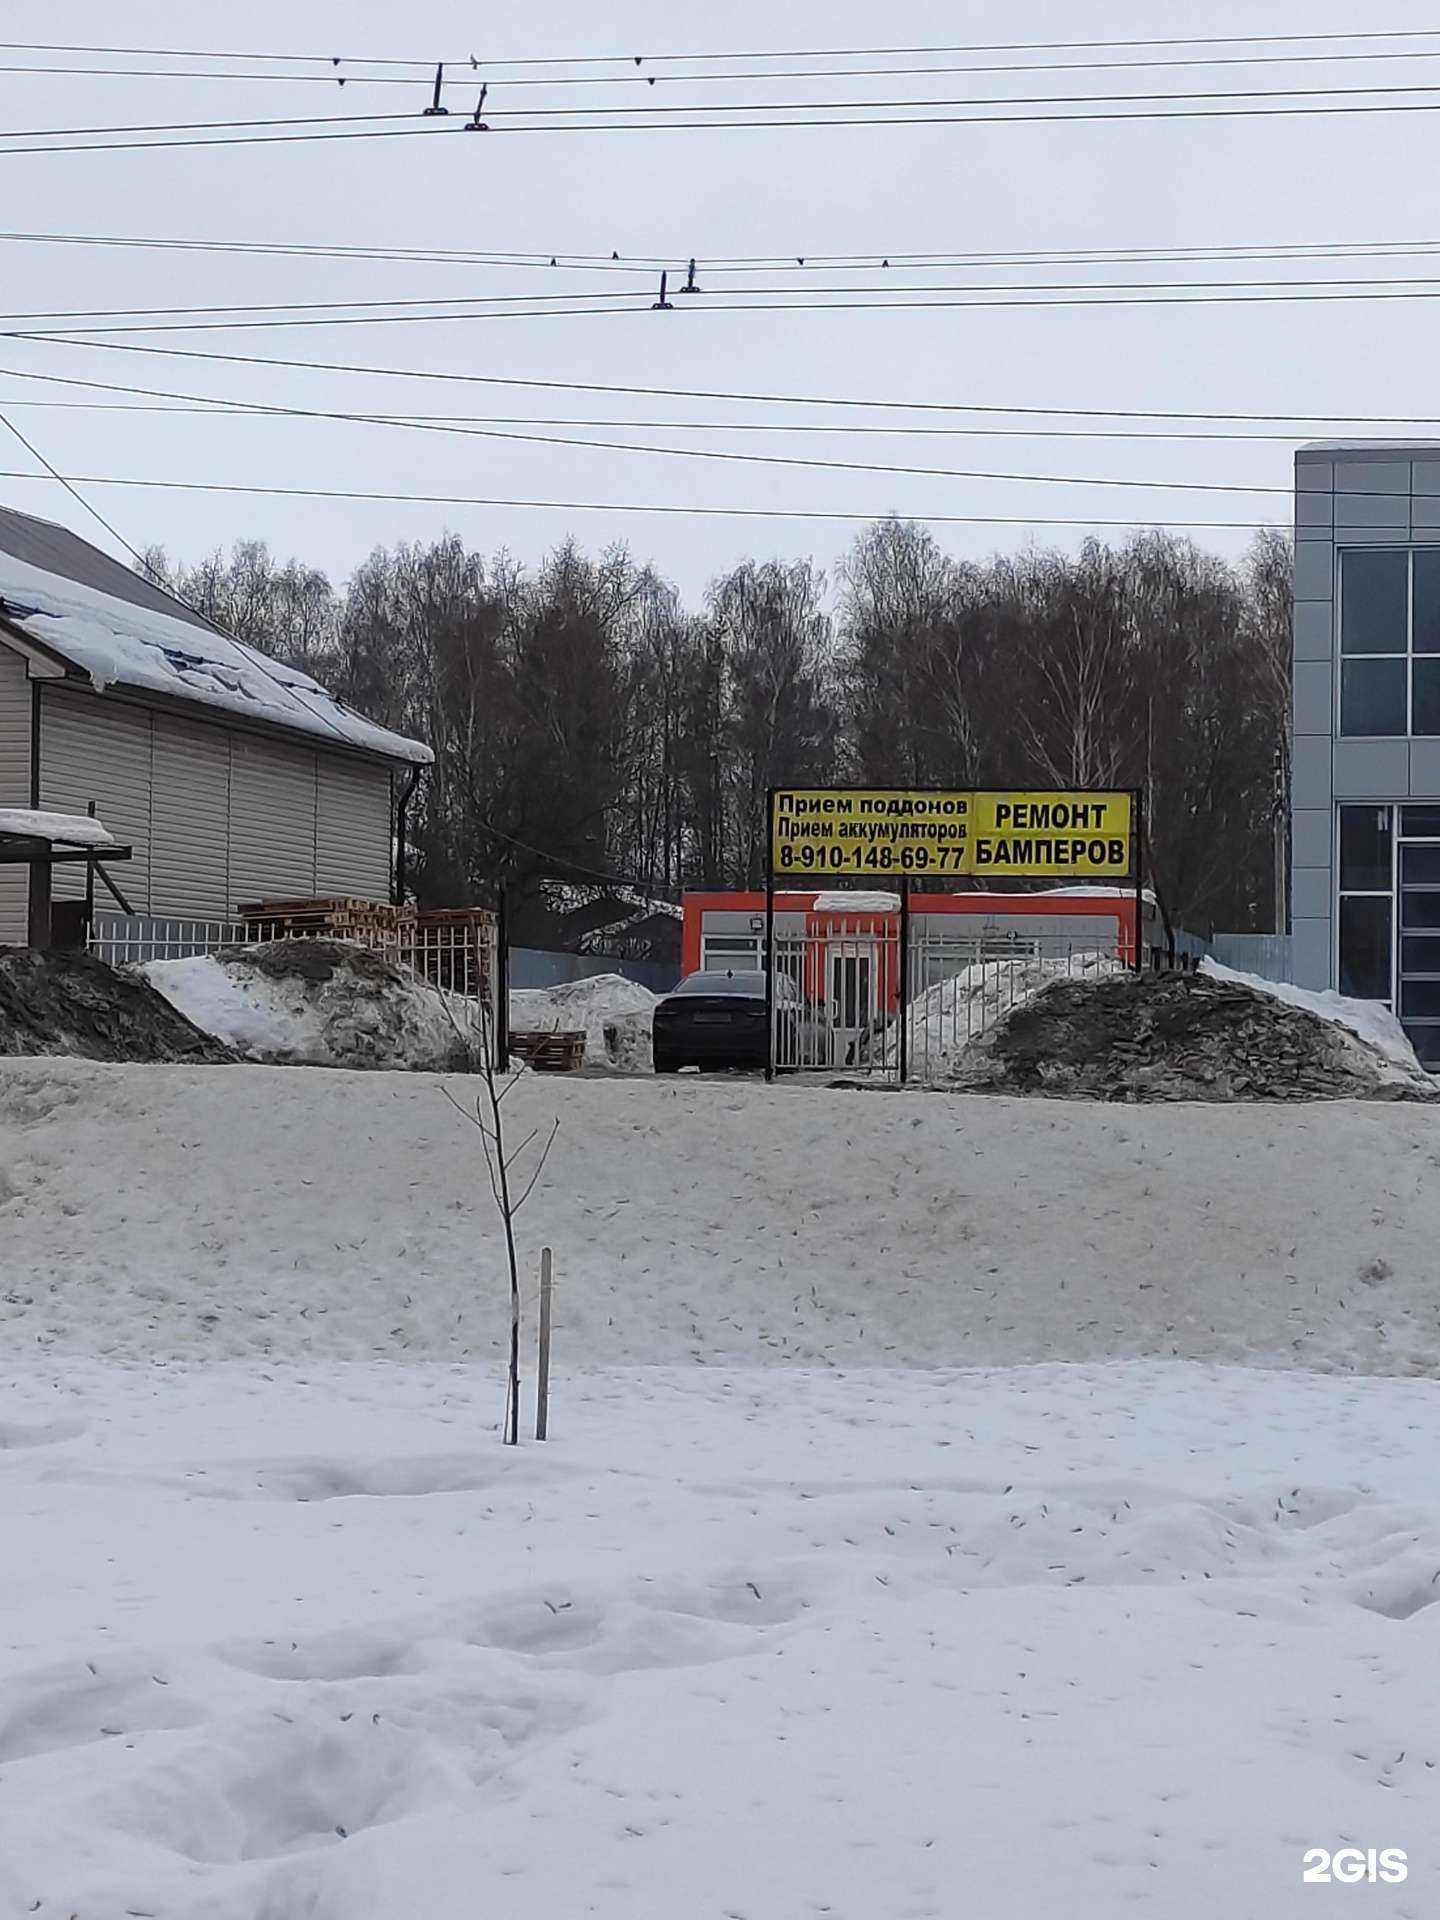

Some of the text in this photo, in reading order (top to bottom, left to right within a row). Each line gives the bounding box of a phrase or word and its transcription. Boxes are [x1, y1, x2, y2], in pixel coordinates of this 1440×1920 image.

[779, 794, 968, 815] Прием поддонов
[996, 803, 1107, 829] РЕМОНТ
[778, 816, 967, 840] Прием аккумуляторов
[780, 845, 964, 870] 8-910-148-69-77
[976, 838, 1124, 865] БАМПЕРОВ
